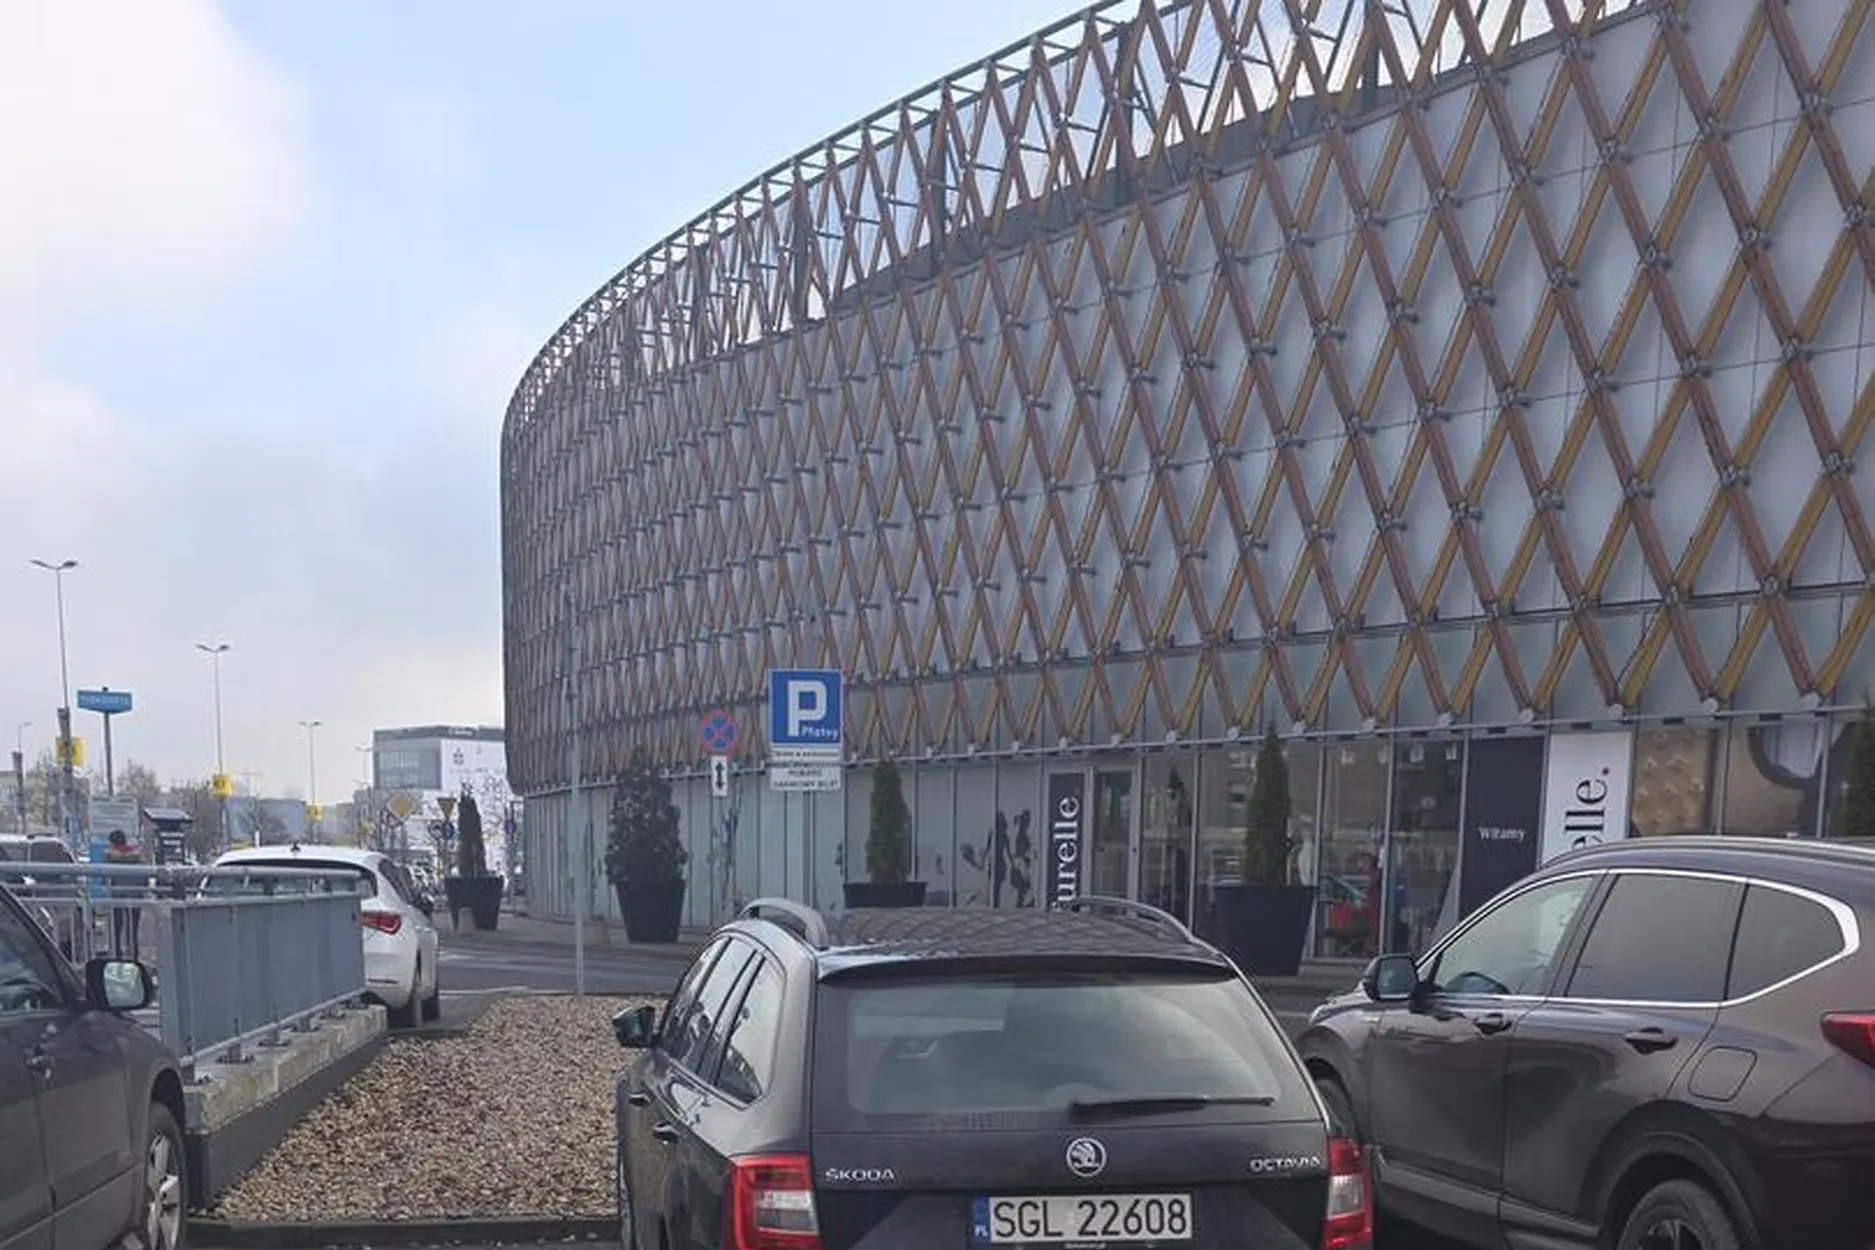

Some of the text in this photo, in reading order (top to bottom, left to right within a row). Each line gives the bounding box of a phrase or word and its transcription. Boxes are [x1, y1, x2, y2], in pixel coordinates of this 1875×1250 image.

[788, 680, 827, 737] P
[1250, 1156, 1320, 1171] OCTAVIA
[994, 1198, 1187, 1238] SGL 22608
